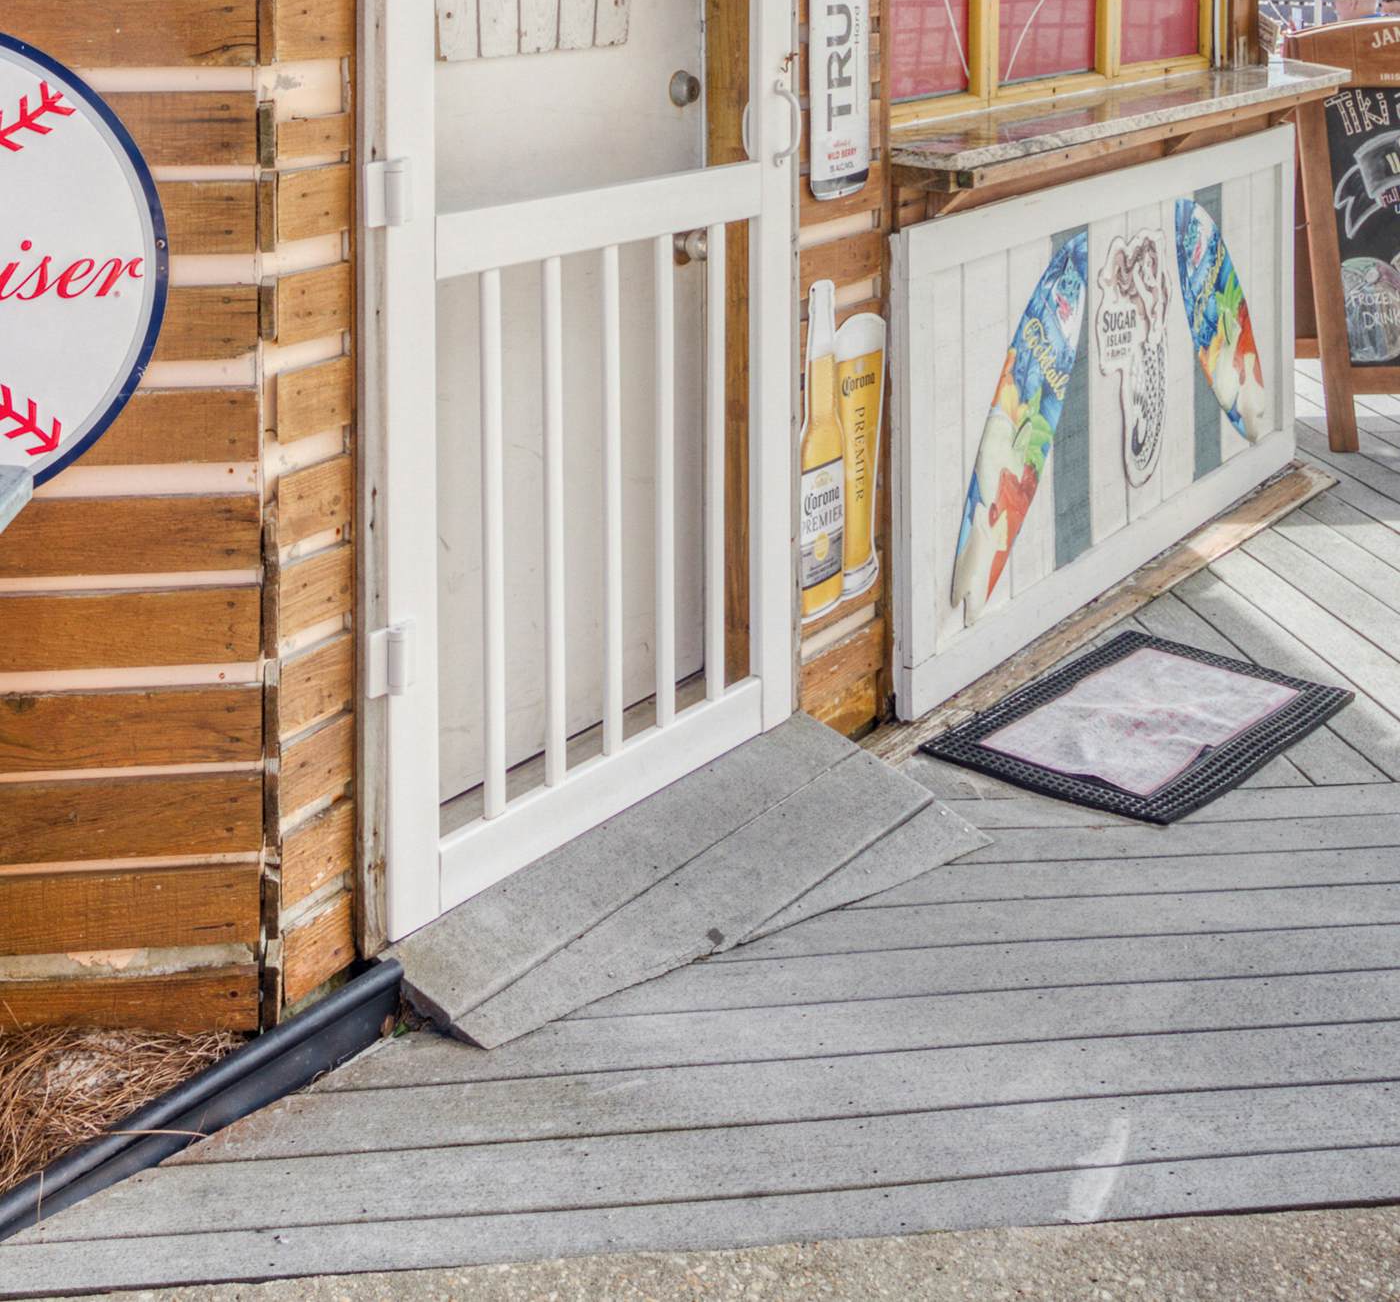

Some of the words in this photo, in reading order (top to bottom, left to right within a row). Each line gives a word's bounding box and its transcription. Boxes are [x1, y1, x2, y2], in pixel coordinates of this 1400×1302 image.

[1323, 89, 1390, 136] Tiki
[1102, 309, 1137, 333] SUGAR
[1106, 331, 1132, 347] ISLAND
[841, 372, 876, 396] Corona
[854, 406, 865, 503] PREMIER
[803, 486, 841, 516] Corona
